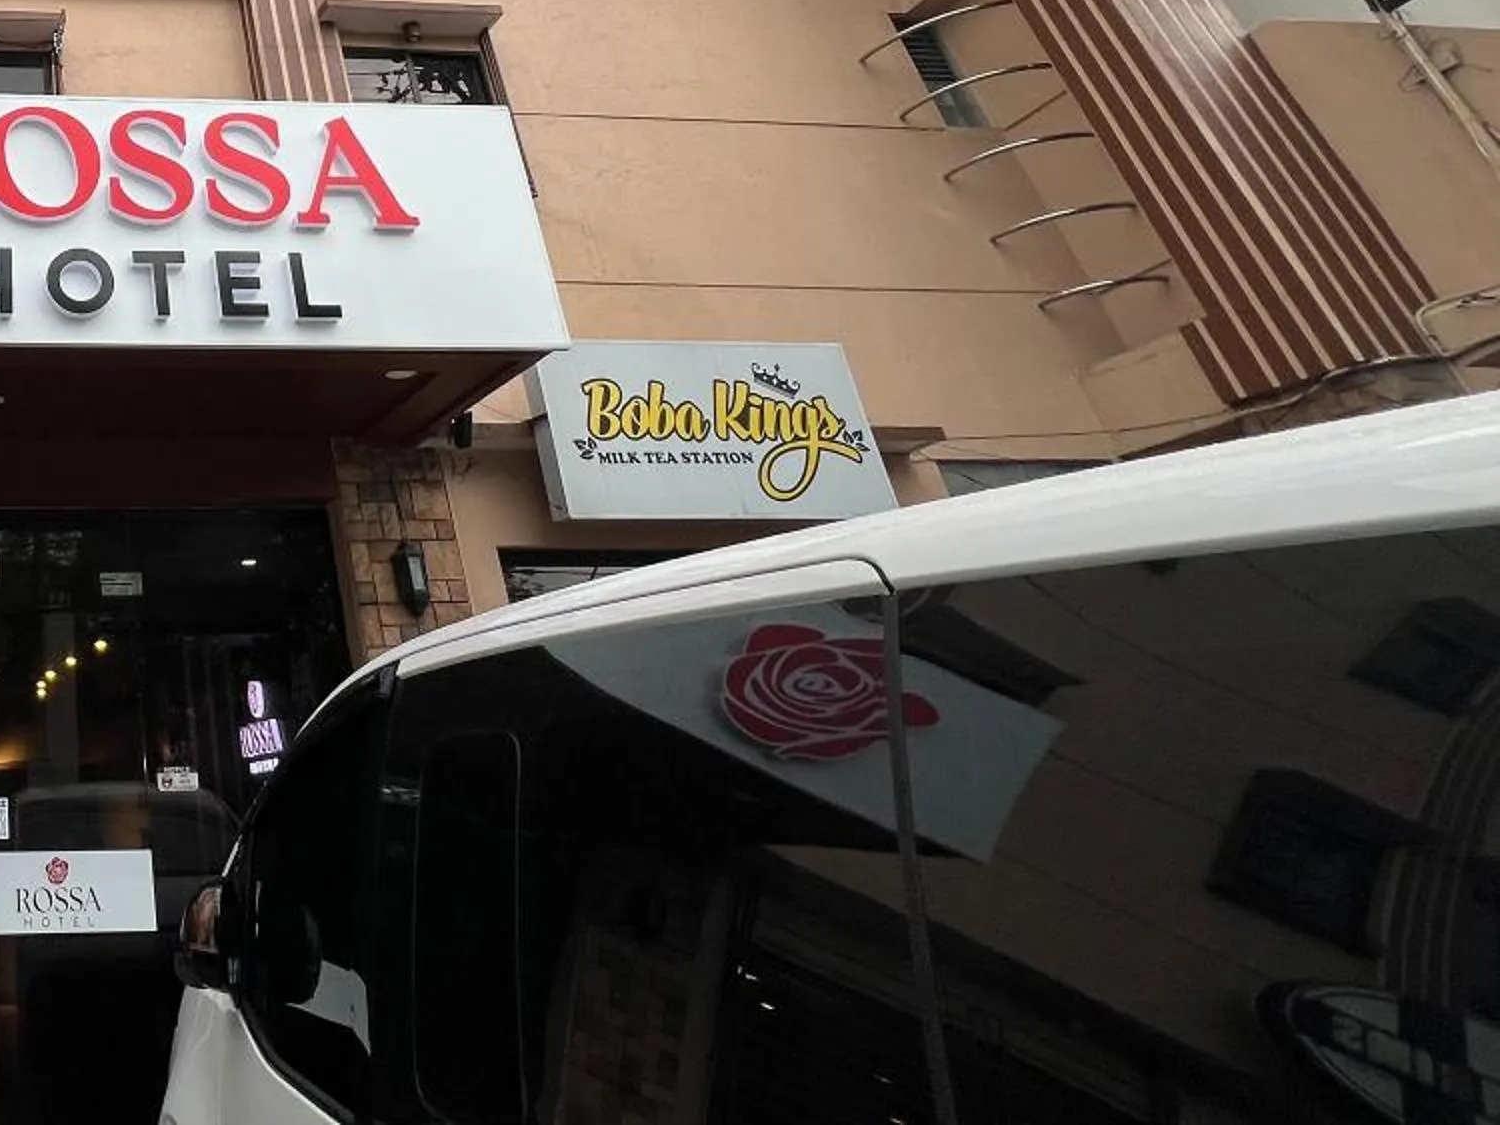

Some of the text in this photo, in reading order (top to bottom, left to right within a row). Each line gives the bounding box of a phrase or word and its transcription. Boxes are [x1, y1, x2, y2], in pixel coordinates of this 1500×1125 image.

[581, 378, 863, 502] Boba Kings
[598, 451, 755, 465] MILK TEA STATION
[16, 886, 102, 914] ROSSA
[24, 916, 96, 928] HOTEL
